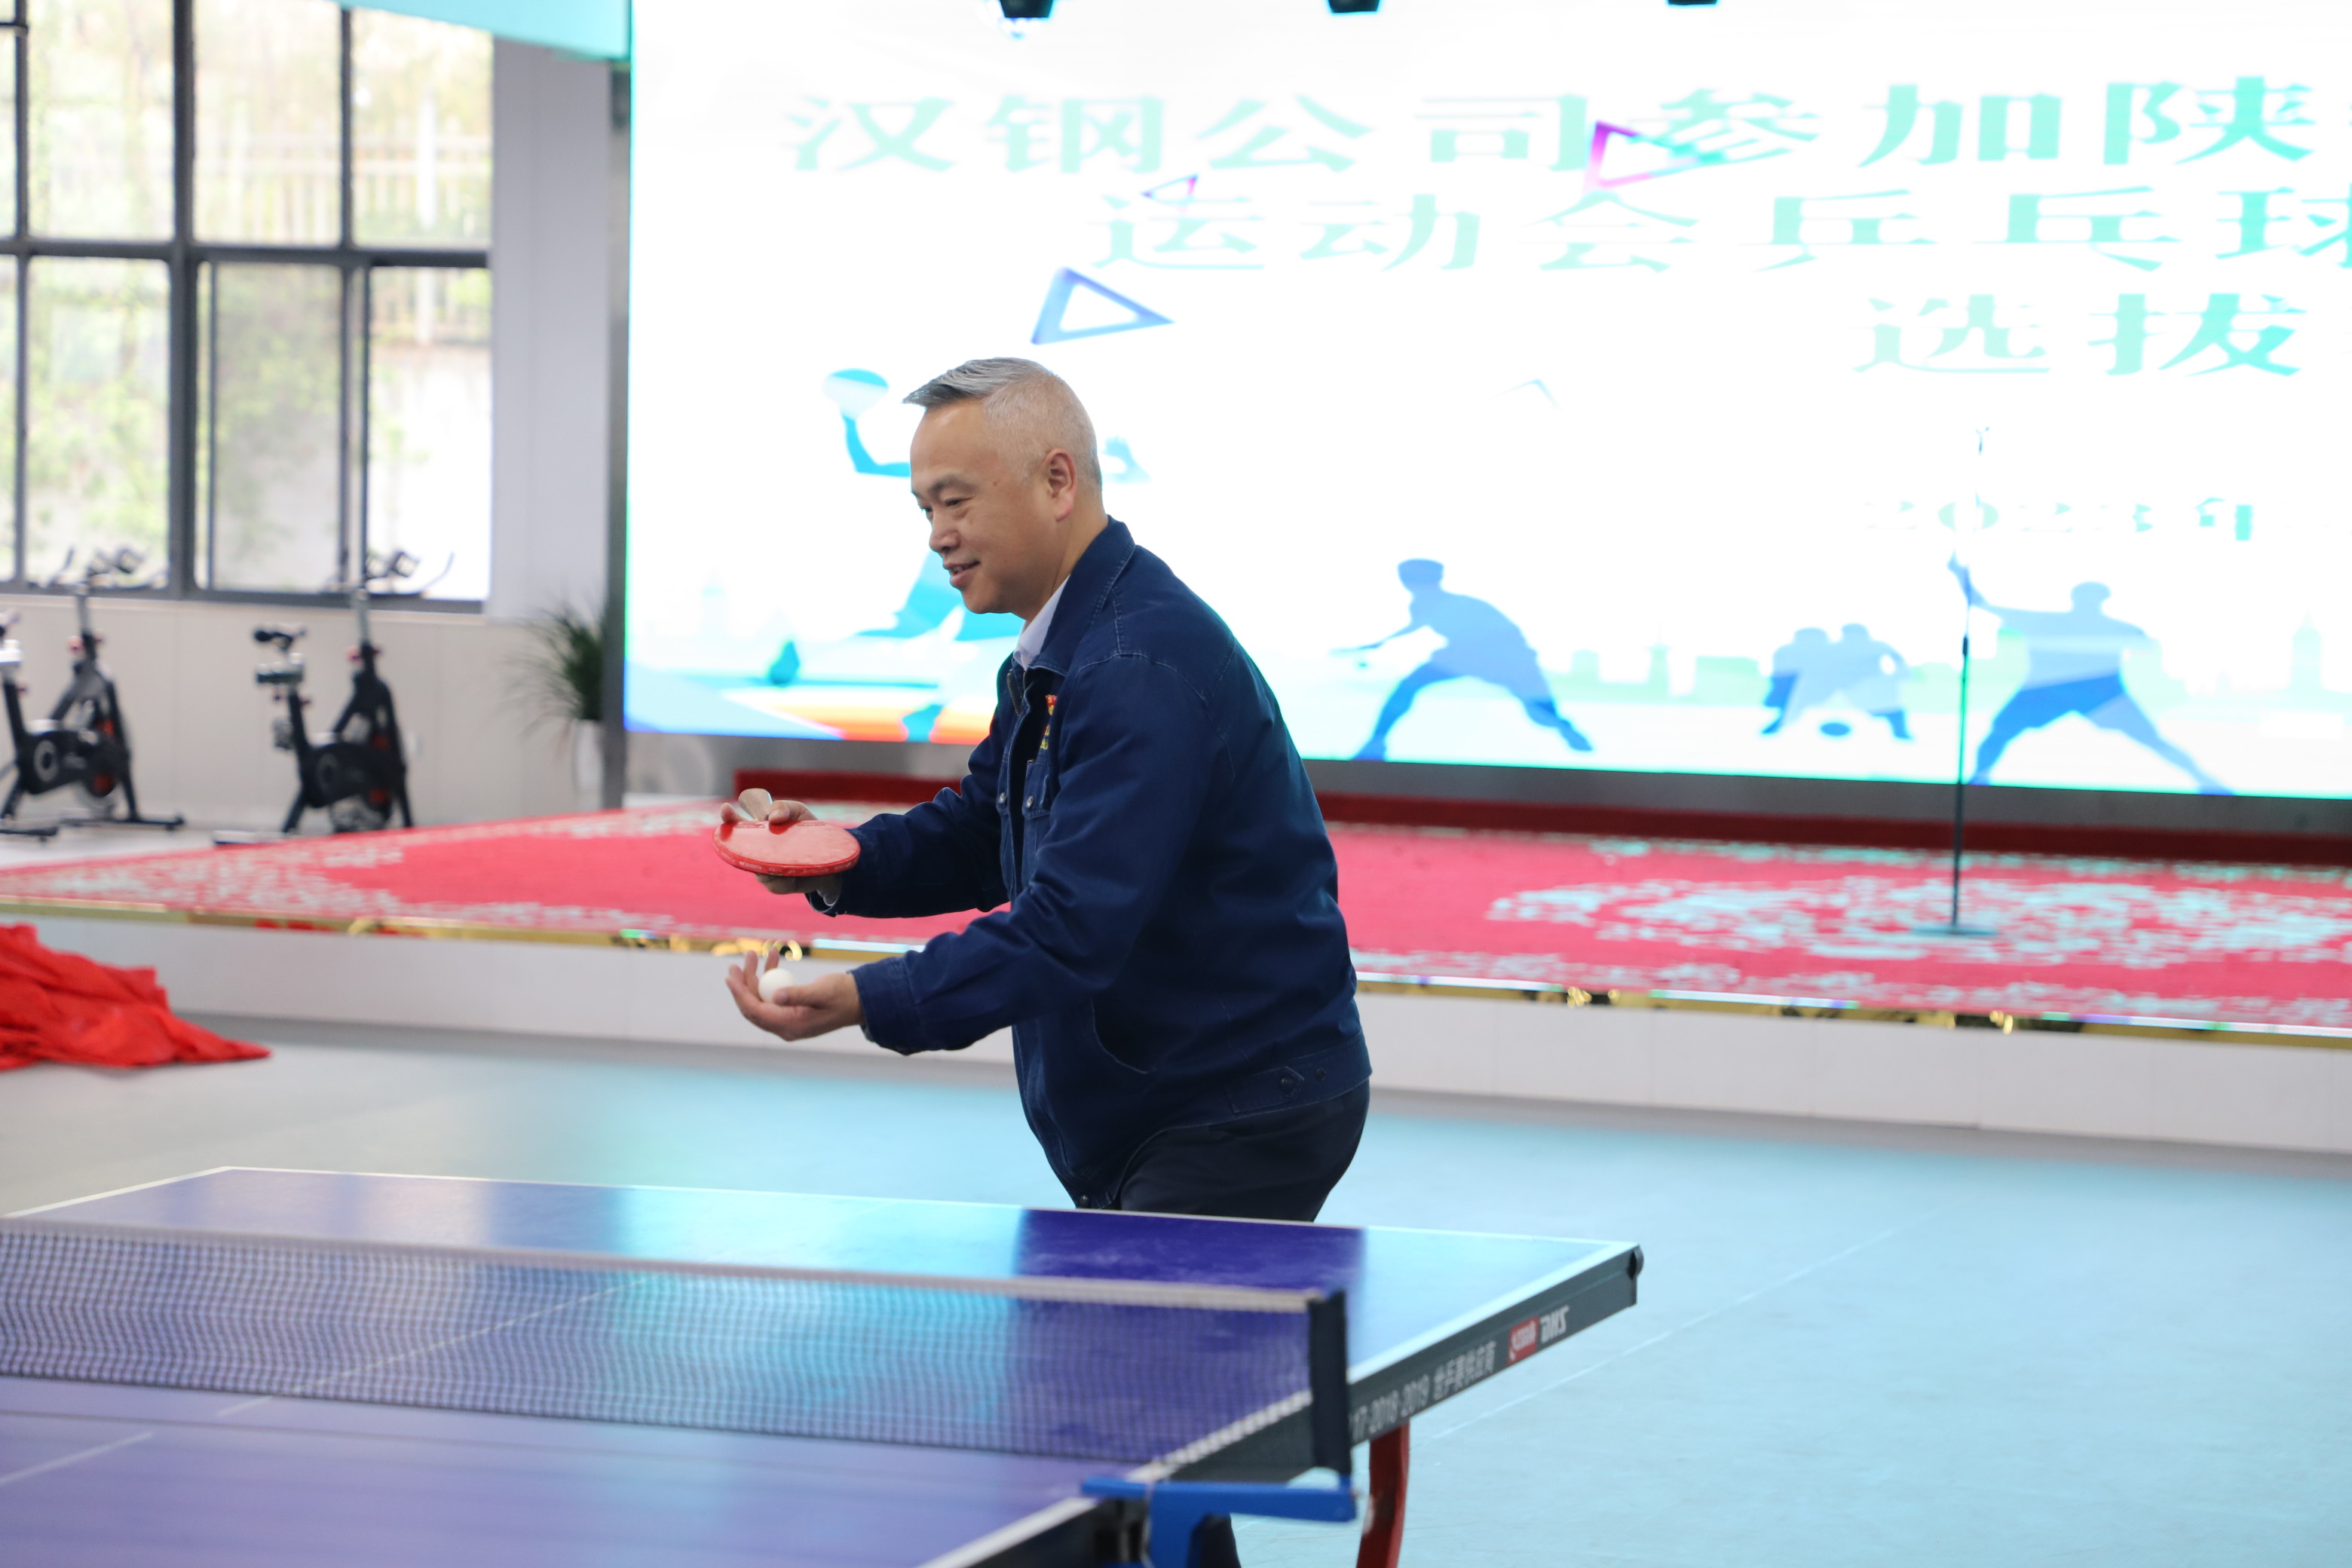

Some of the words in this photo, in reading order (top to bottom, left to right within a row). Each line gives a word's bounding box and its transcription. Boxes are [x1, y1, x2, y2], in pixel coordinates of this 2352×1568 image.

[784, 74, 2352, 175] 汉钢公司参加陕
[1089, 181, 2352, 274] 运动会乒乓球
[1851, 291, 2352, 378] 选拔
